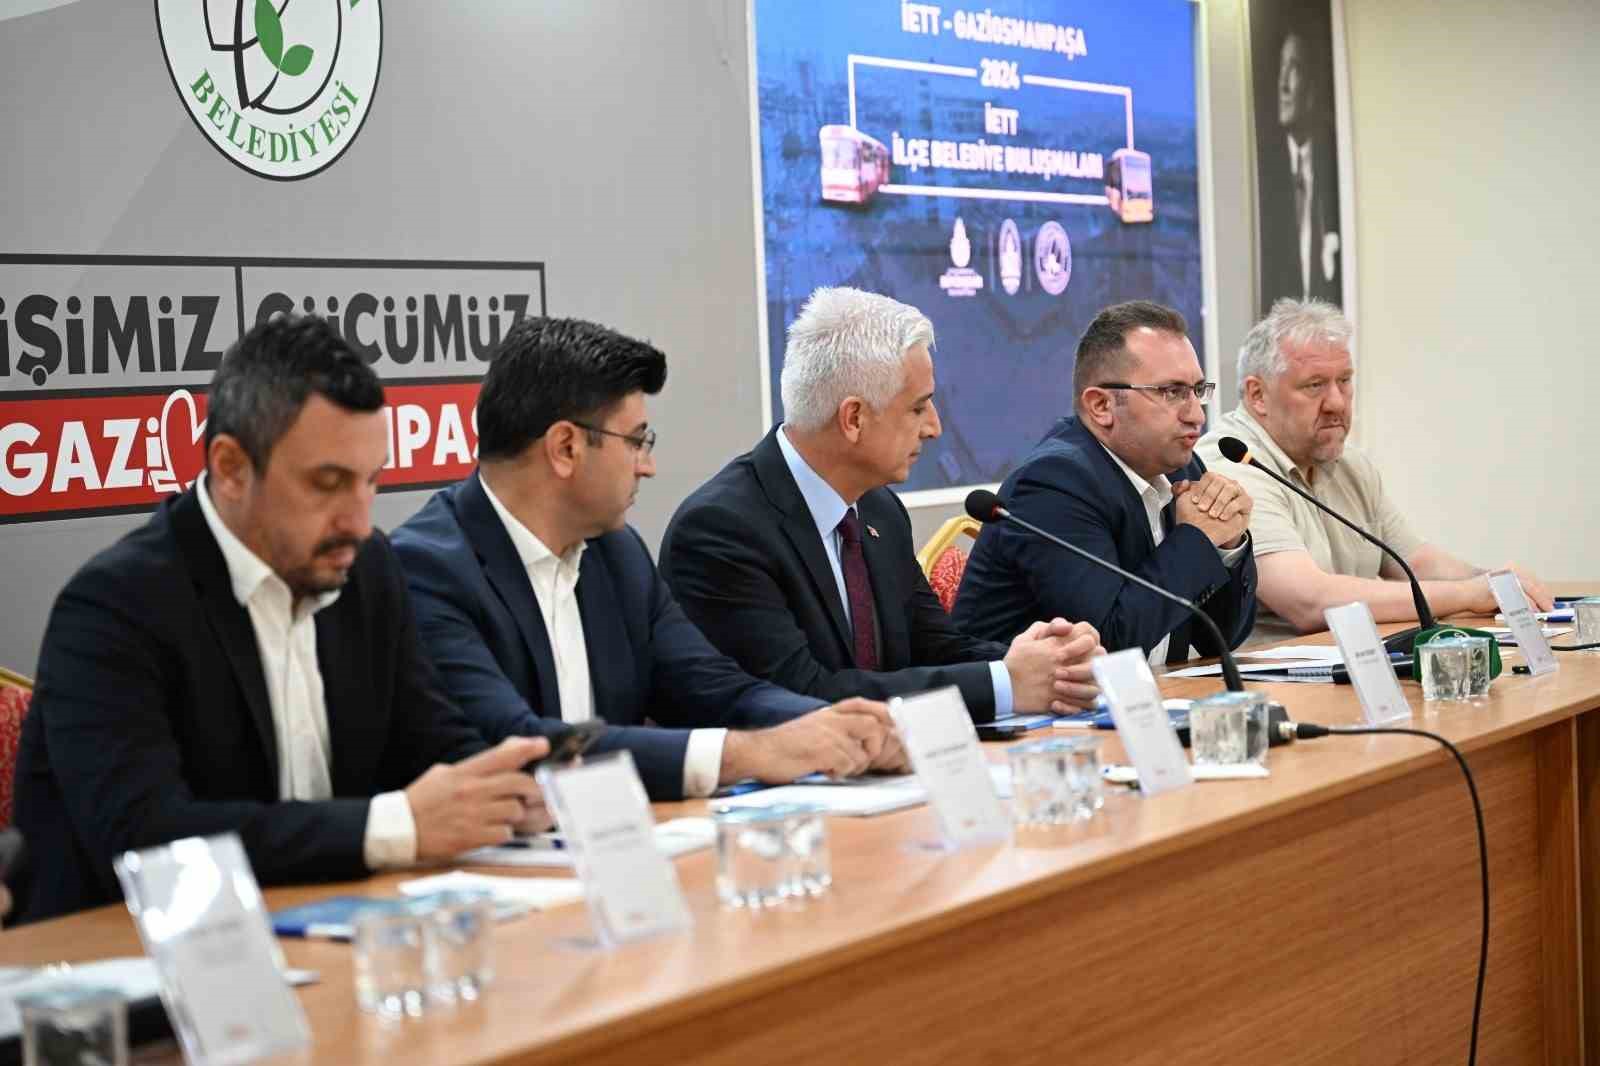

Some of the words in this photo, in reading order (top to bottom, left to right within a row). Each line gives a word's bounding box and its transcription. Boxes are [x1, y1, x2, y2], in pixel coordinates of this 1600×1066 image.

[902, 0, 940, 36] İETT
[980, 57, 1020, 90] 2024
[191, 69, 359, 163] BELEDİYESİ
[984, 101, 1019, 136] İETT
[892, 131, 930, 172] İLÇE
